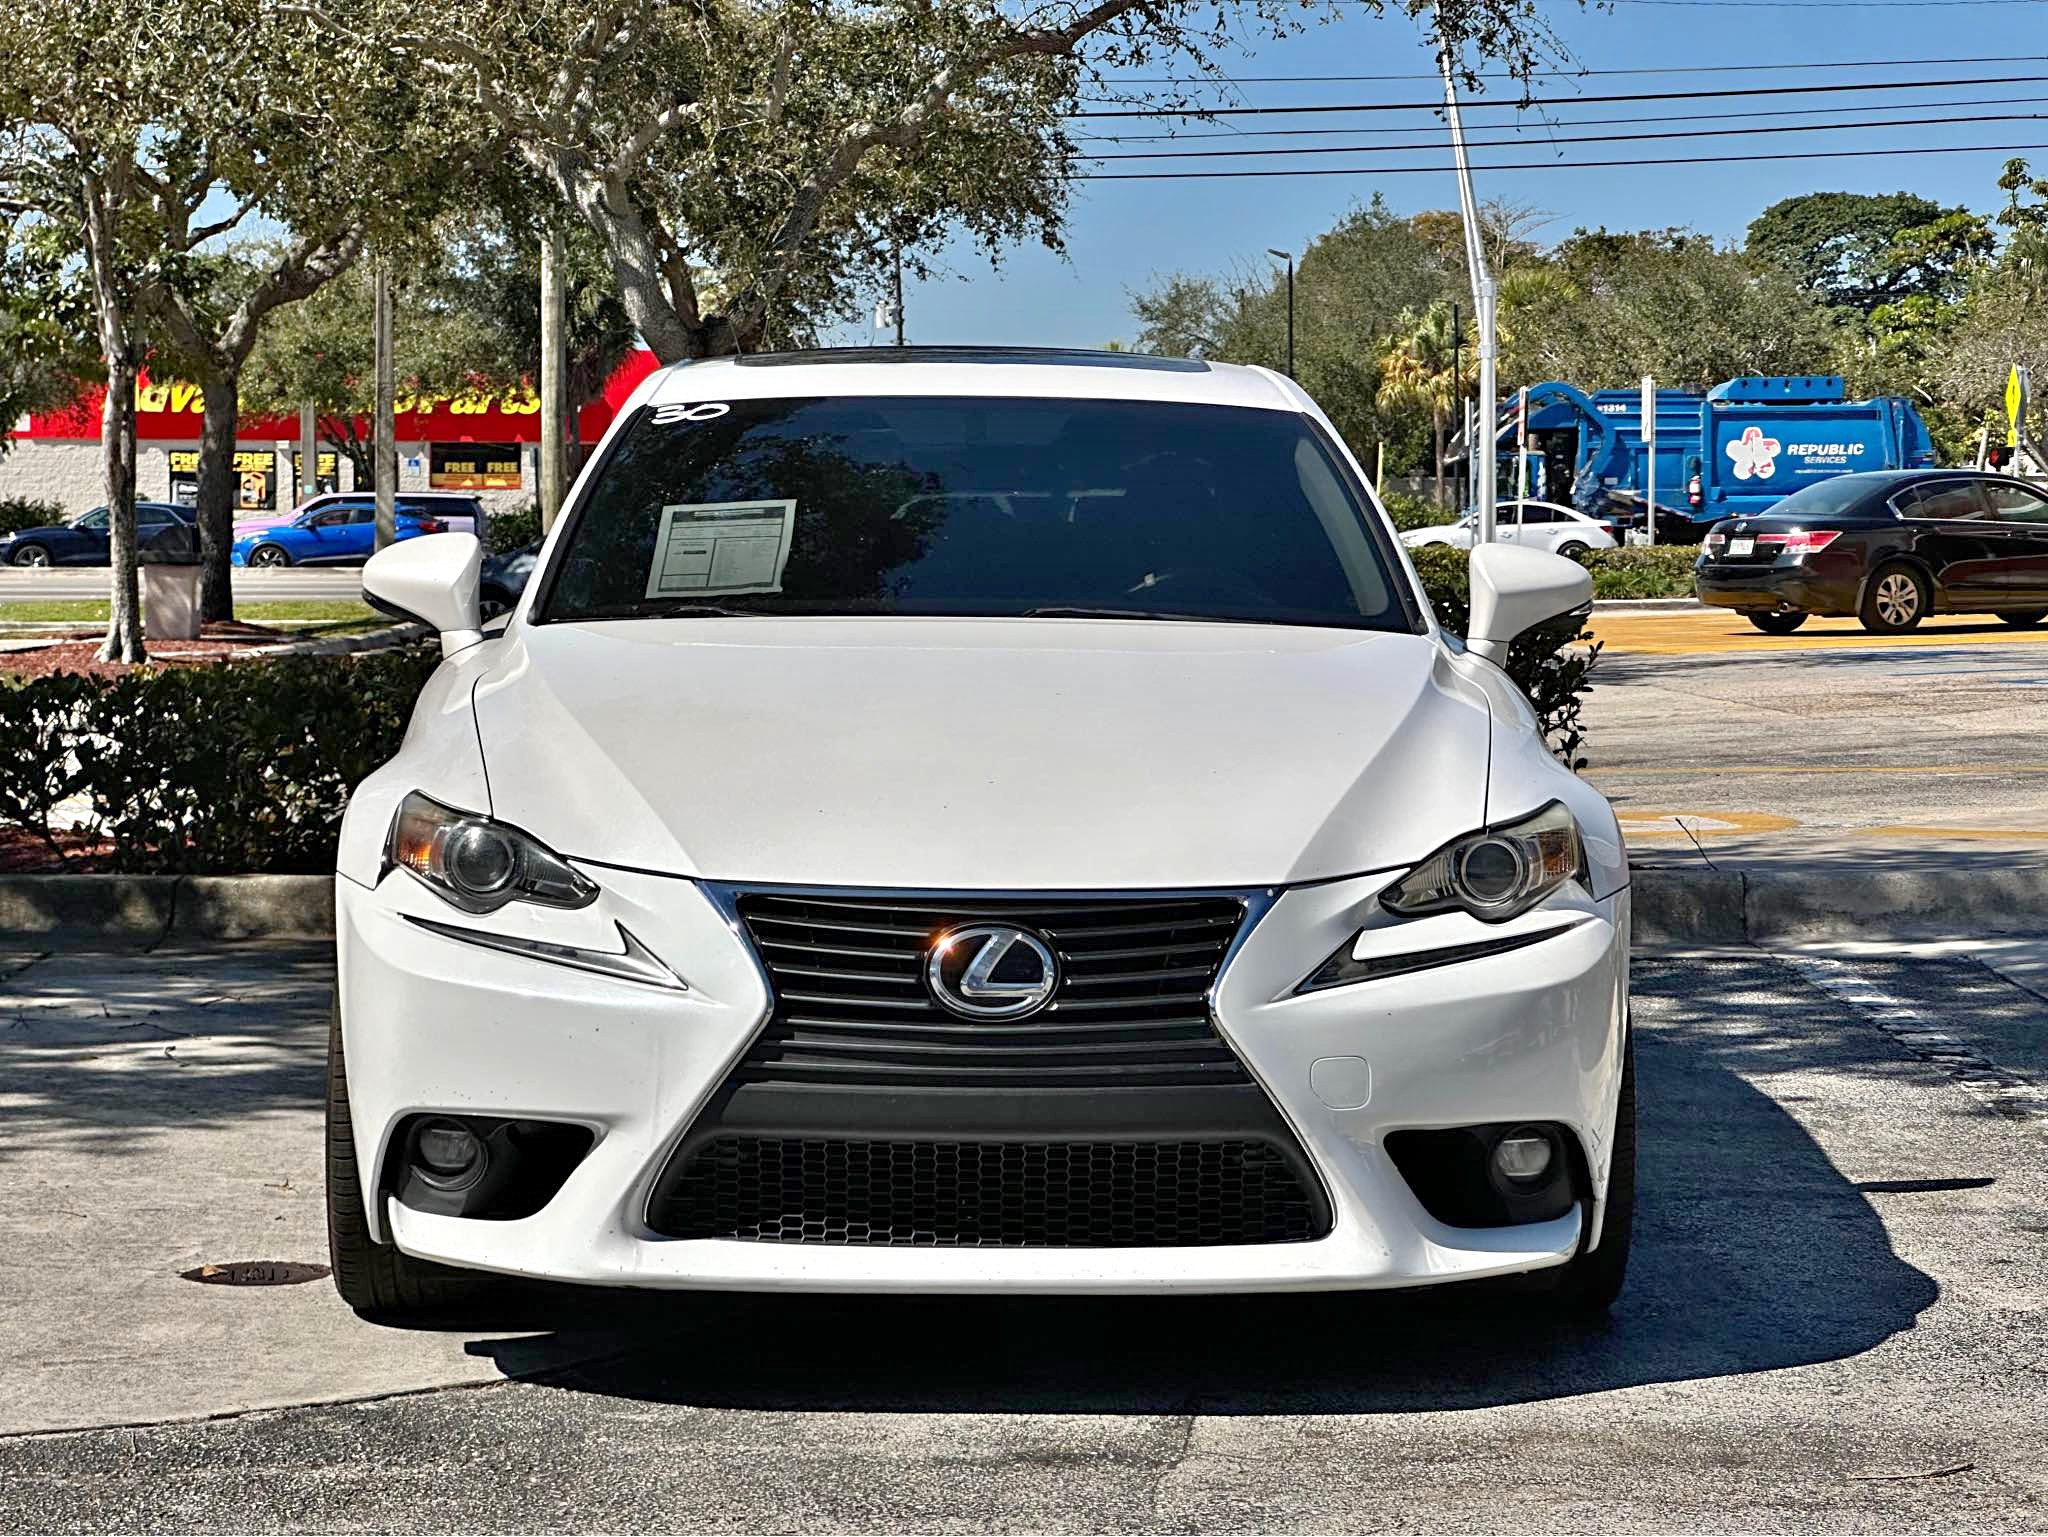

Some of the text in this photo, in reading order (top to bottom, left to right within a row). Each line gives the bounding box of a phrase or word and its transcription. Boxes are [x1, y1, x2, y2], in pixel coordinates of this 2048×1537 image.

[1787, 443, 1865, 456] REPUBLIC
[233, 452, 274, 466] FREE
[1804, 456, 1848, 464] SERVICES
[444, 461, 476, 473] FREE
[487, 461, 518, 473] FREE
